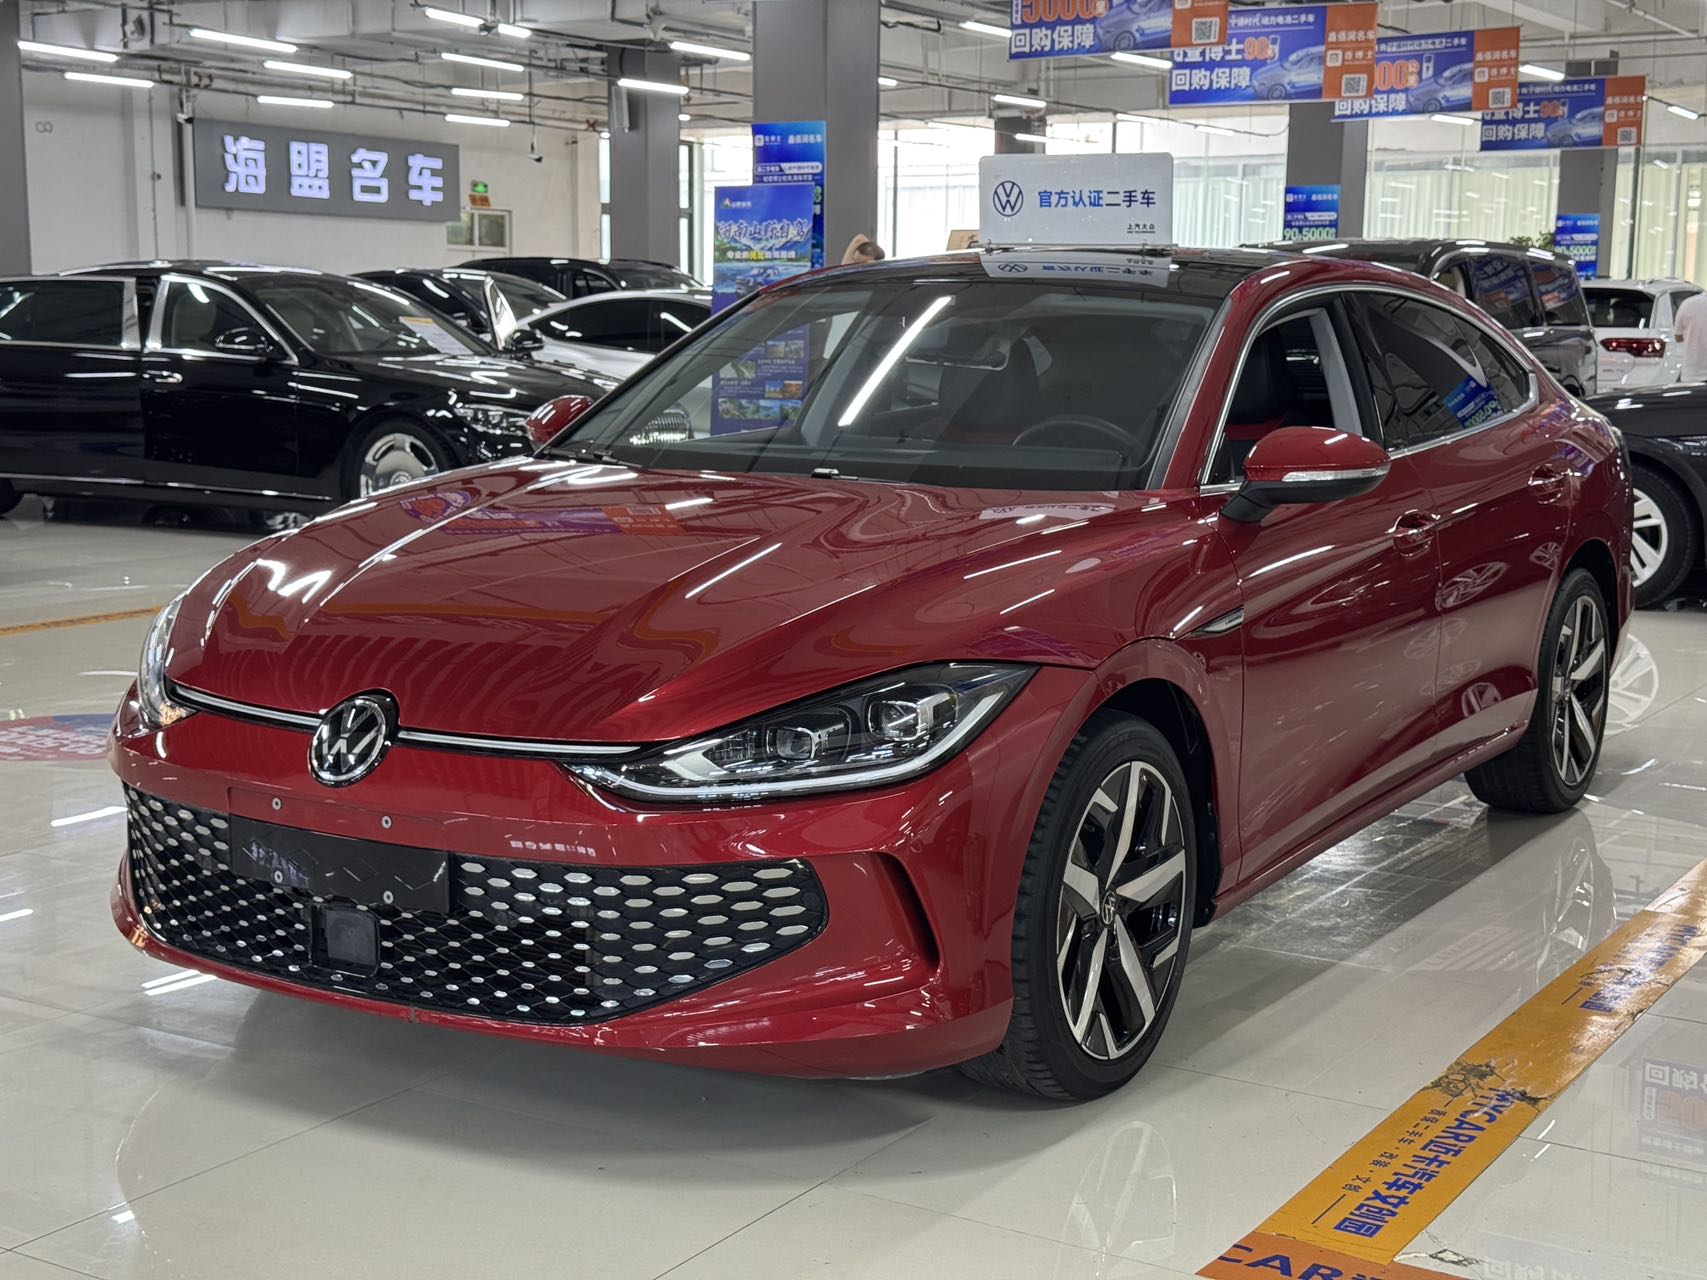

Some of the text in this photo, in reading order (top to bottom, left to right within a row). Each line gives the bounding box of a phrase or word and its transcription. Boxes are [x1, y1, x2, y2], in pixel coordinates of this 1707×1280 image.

[1010, 24, 1096, 54] 回购保障
[1171, 66, 1252, 92] 回购保障
[1334, 93, 1407, 117] 回购保障
[1482, 122, 1546, 142] 回购保障
[223, 135, 444, 207] 海盟名车
[1038, 189, 1157, 208] 官方认证二手车
